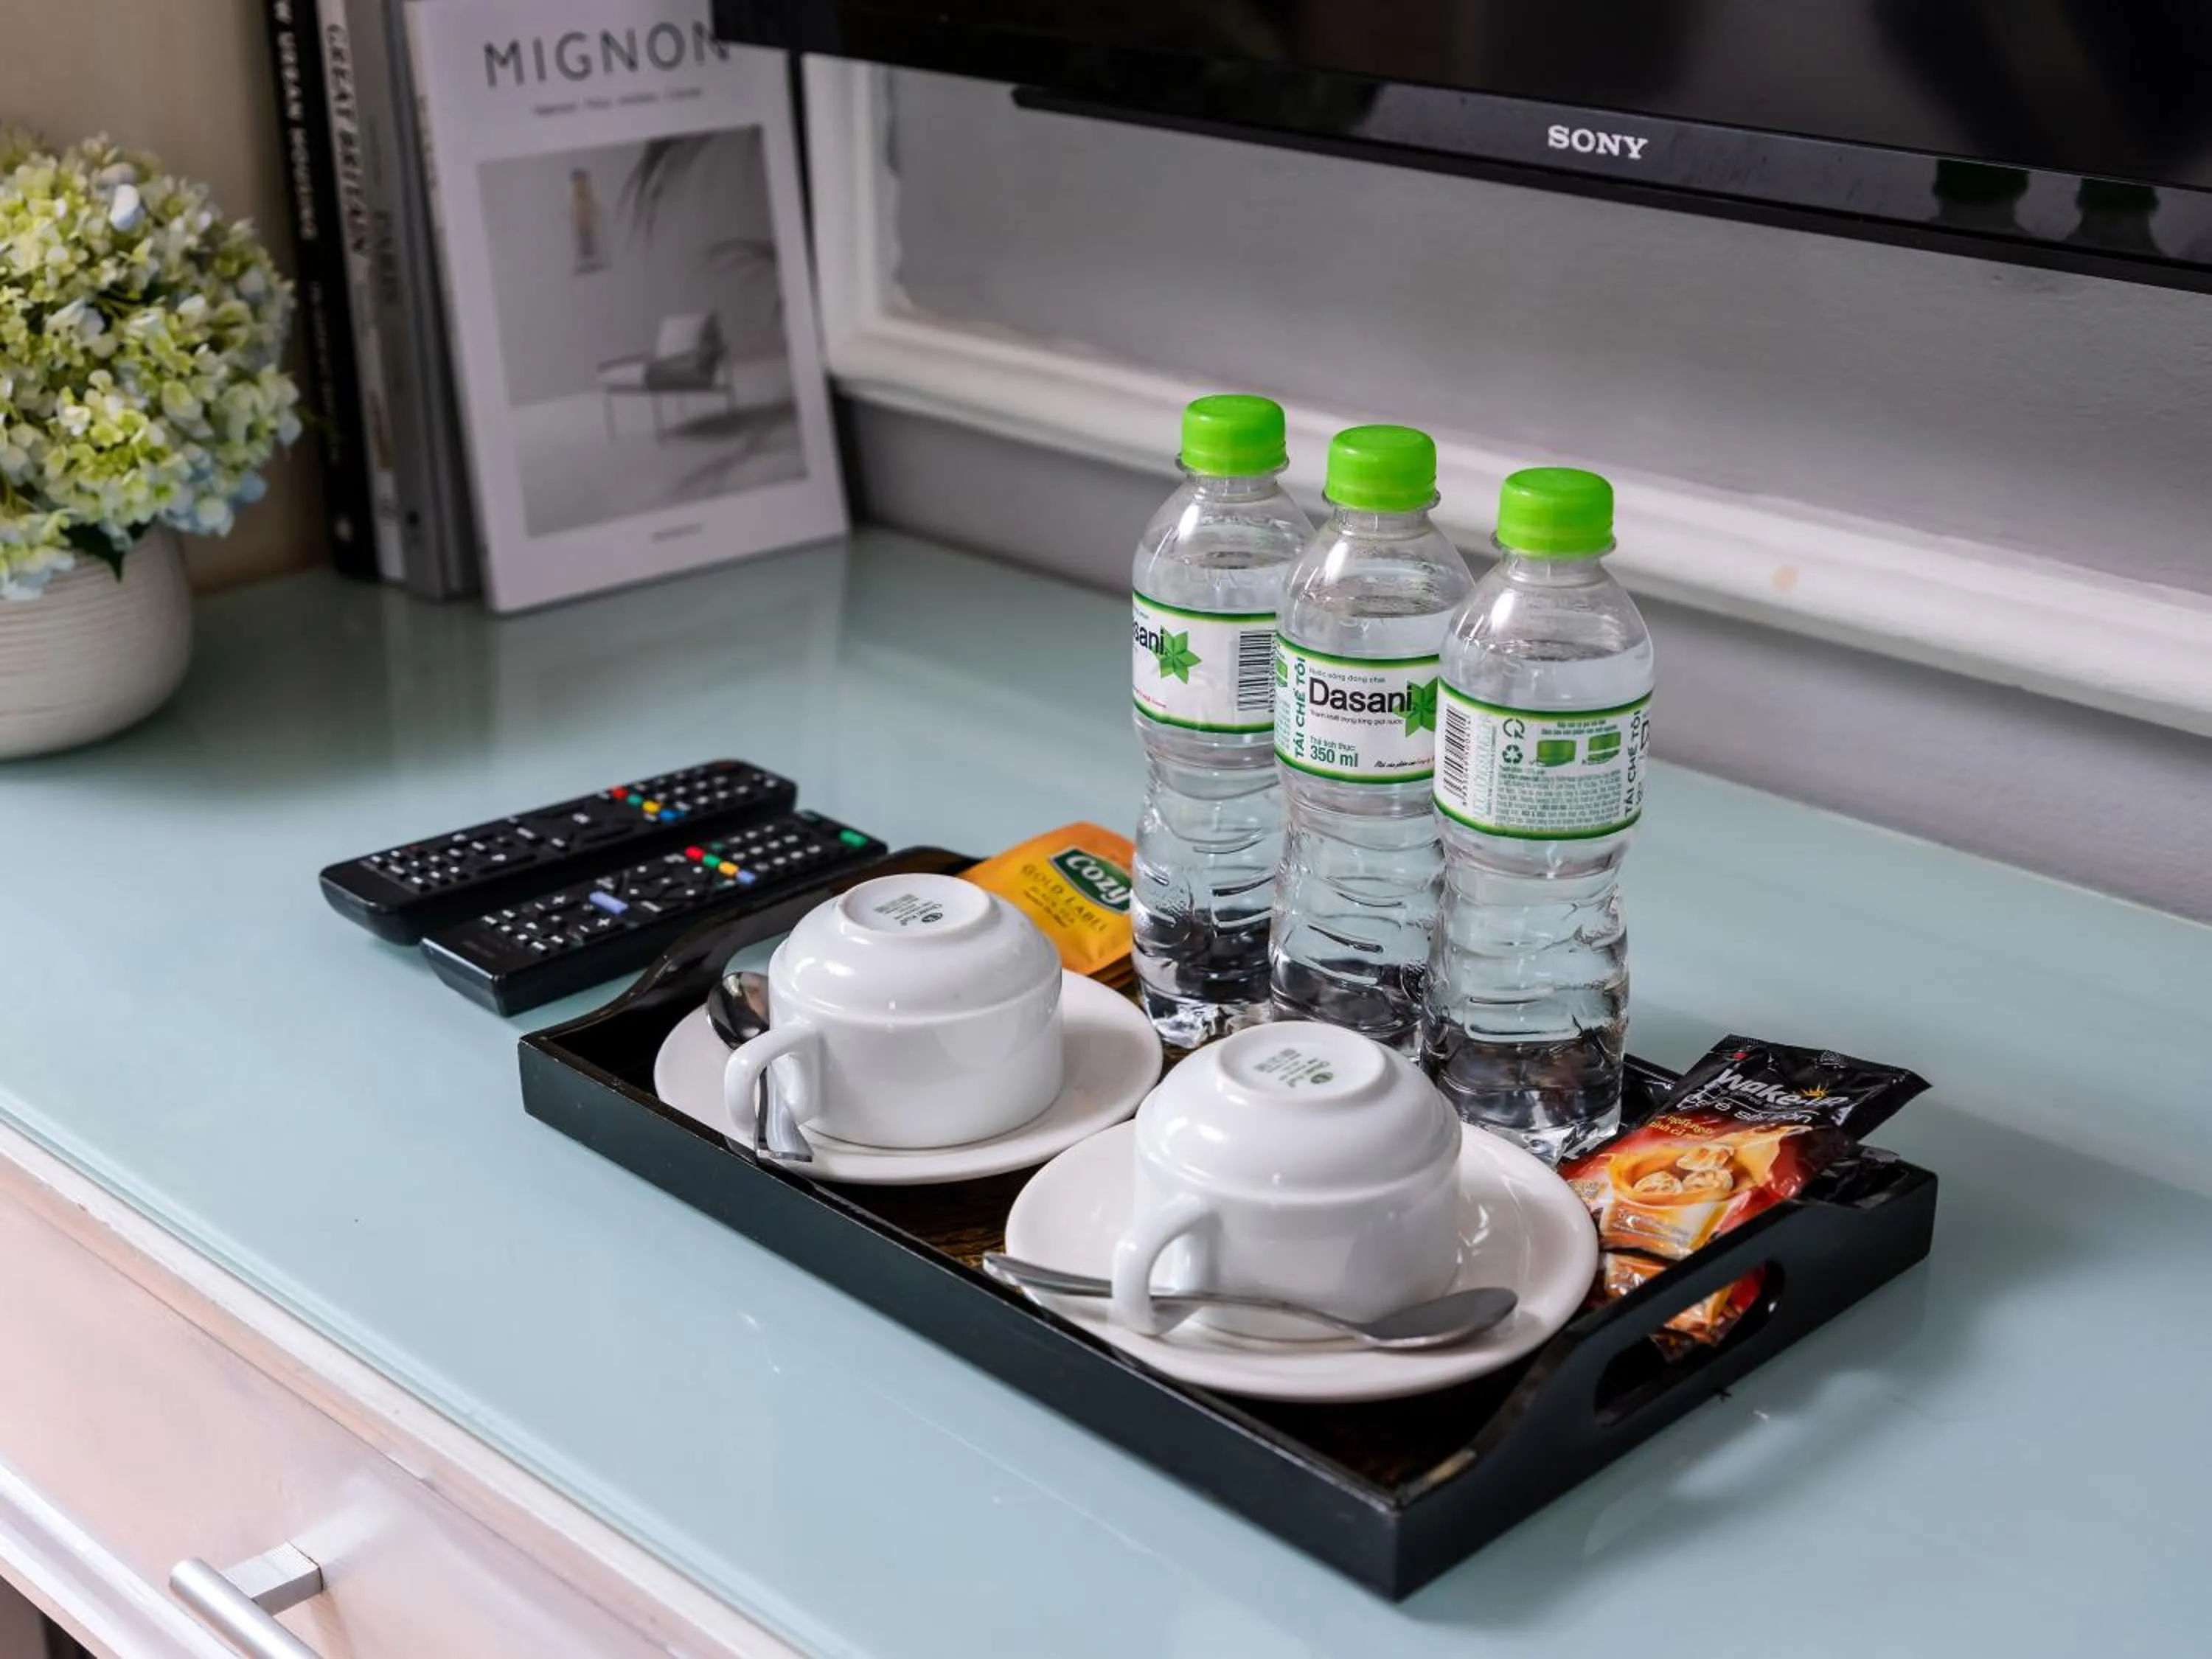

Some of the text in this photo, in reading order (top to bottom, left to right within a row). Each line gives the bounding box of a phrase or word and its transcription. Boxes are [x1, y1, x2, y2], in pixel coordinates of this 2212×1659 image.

[483, 19, 730, 89] MIGNON
[1548, 124, 1649, 159] SONY
[1310, 677, 1413, 713] Dasani
[1310, 745, 1359, 768] 350 ml
